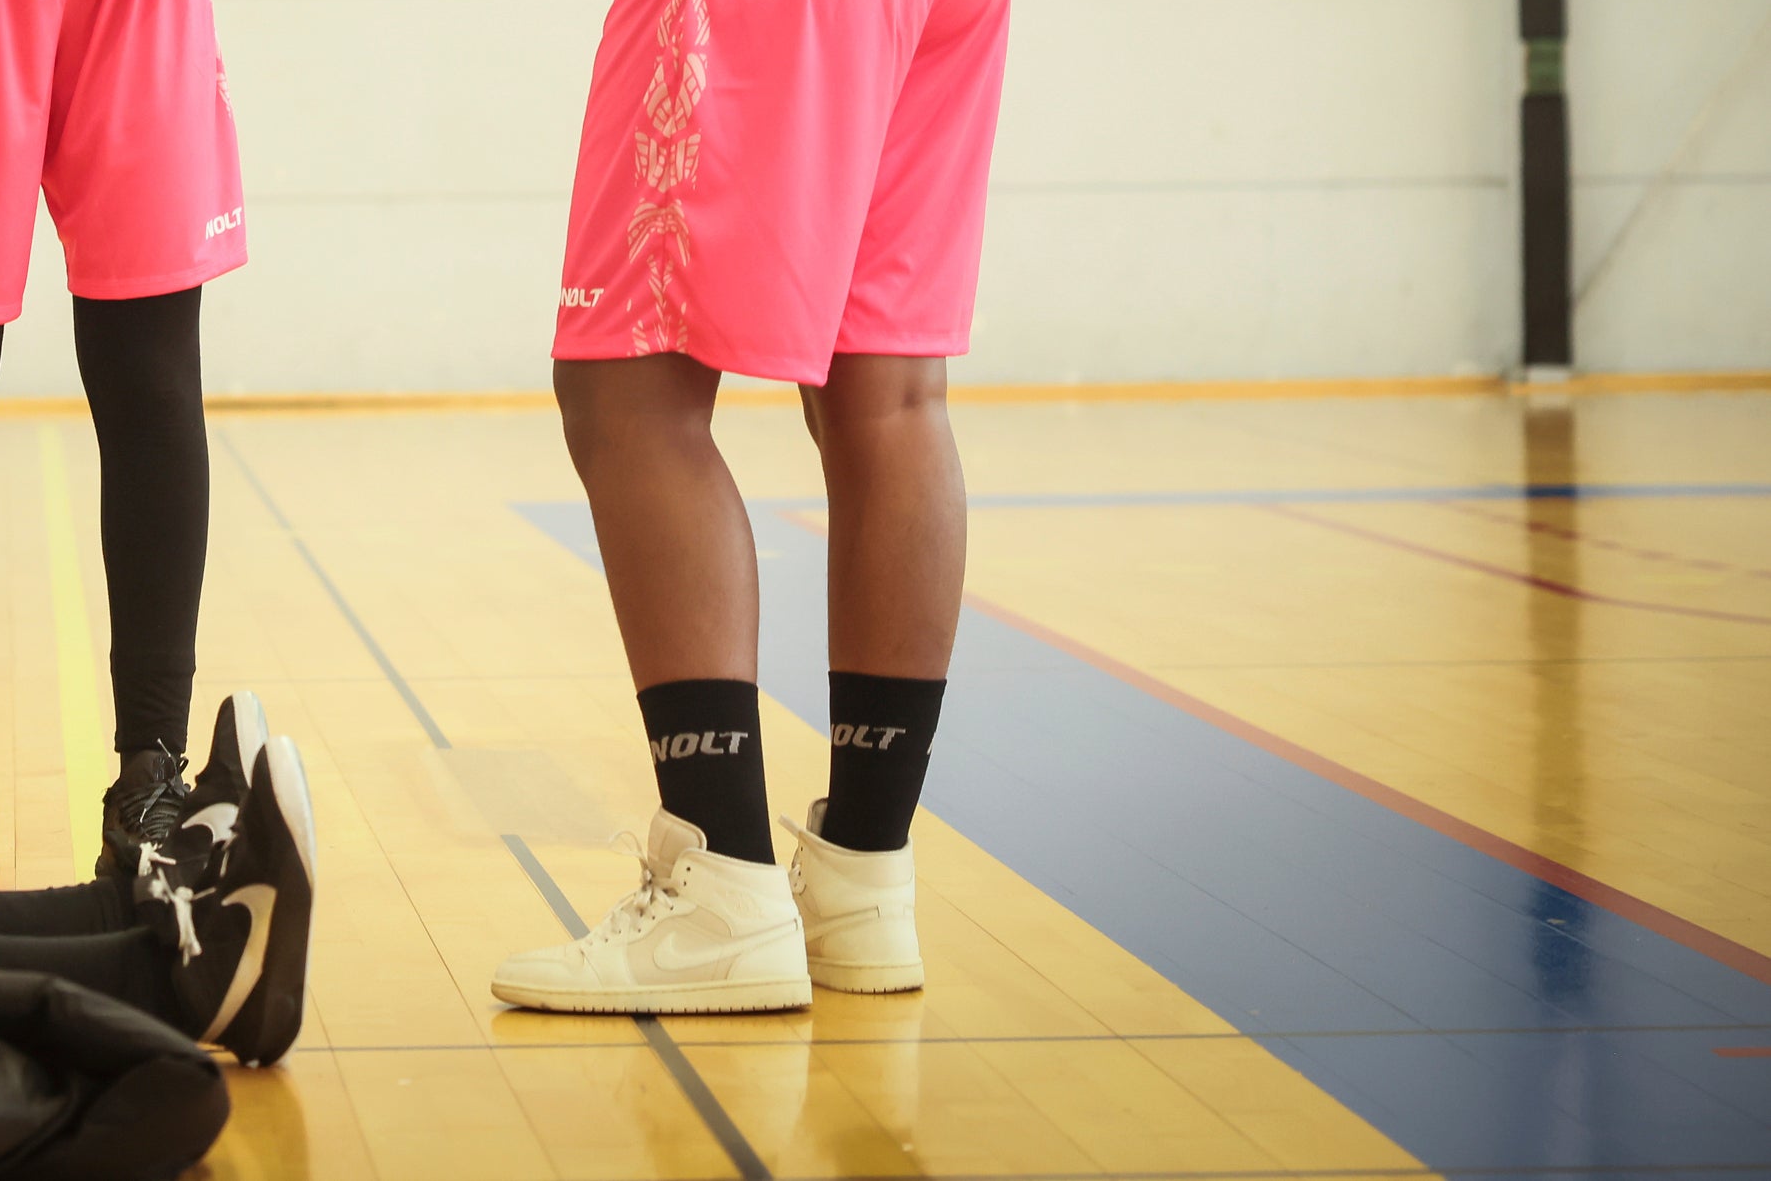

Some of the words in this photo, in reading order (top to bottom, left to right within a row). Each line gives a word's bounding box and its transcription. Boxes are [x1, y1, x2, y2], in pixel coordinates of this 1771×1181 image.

[205, 206, 243, 240] NOLT
[560, 287, 604, 307] NOLT
[650, 731, 749, 765] NOLT
[830, 723, 906, 750] OLT
